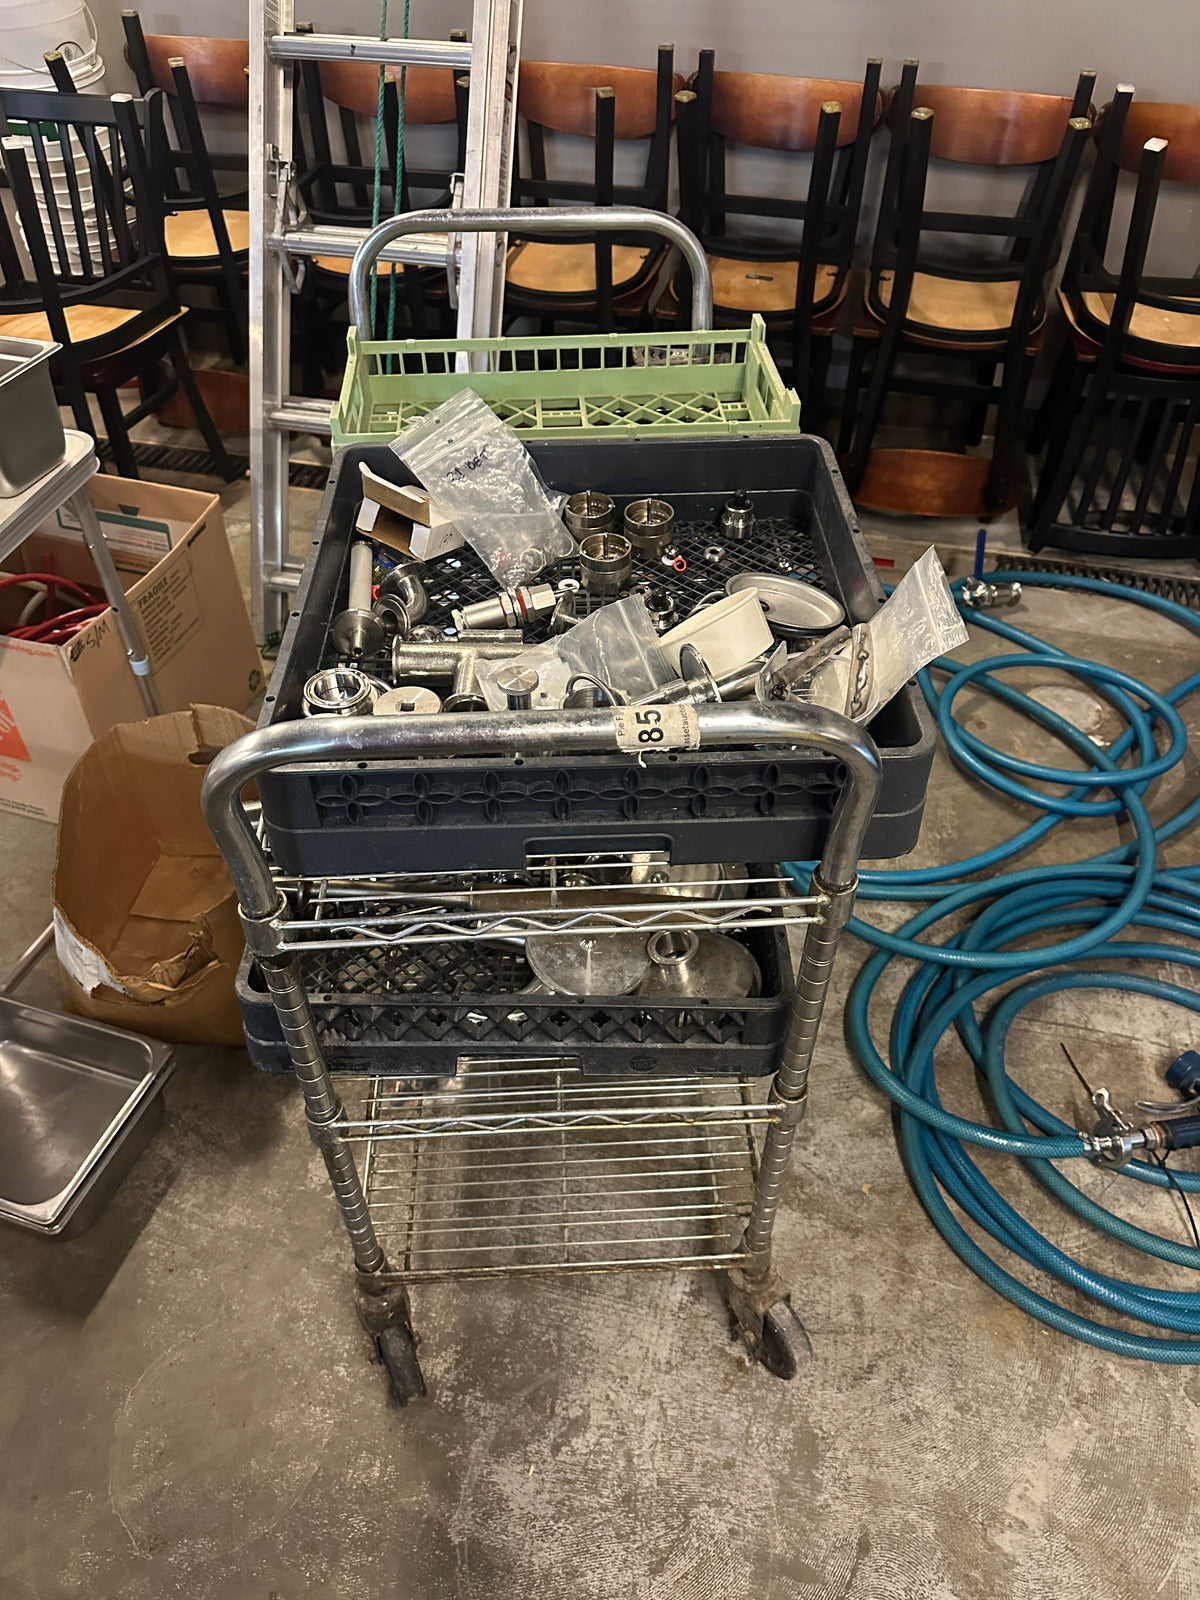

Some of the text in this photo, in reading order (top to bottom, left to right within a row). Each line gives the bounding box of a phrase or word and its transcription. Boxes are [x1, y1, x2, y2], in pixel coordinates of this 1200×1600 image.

[138, 576, 168, 608] FRAGILE
[86, 619, 110, 649] S/M
[635, 710, 664, 743] 85
